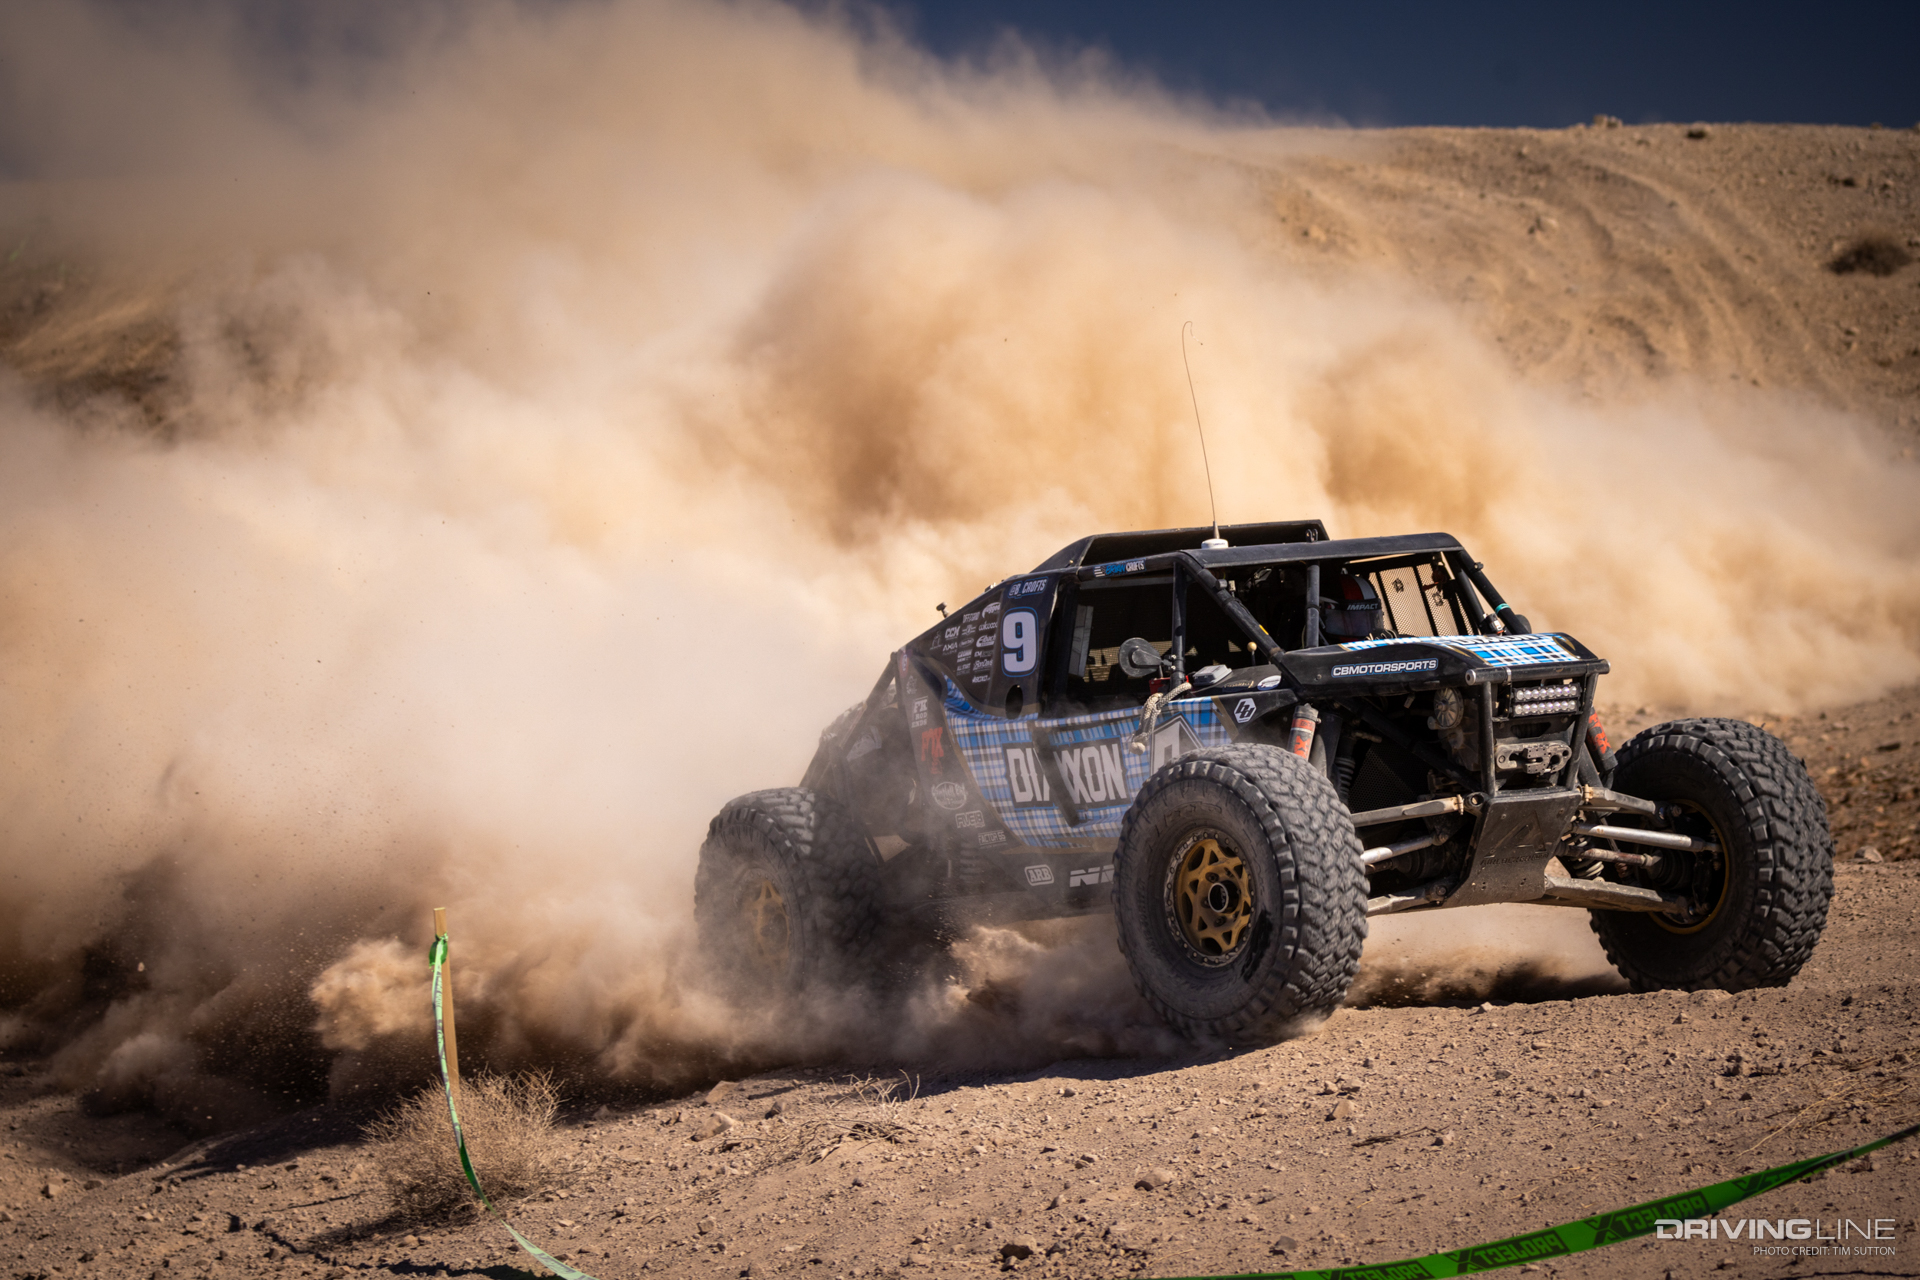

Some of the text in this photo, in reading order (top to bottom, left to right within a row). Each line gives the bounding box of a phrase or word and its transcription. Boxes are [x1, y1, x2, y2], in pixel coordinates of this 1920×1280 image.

[1125, 560, 1145, 573] CROFTS
[1346, 603, 1379, 611] IMPACT
[1002, 611, 1037, 673] 9
[1333, 660, 1437, 677] CBMOTORSPORTS
[1006, 744, 1128, 804] DIXON
[1028, 867, 1052, 882] ARB
